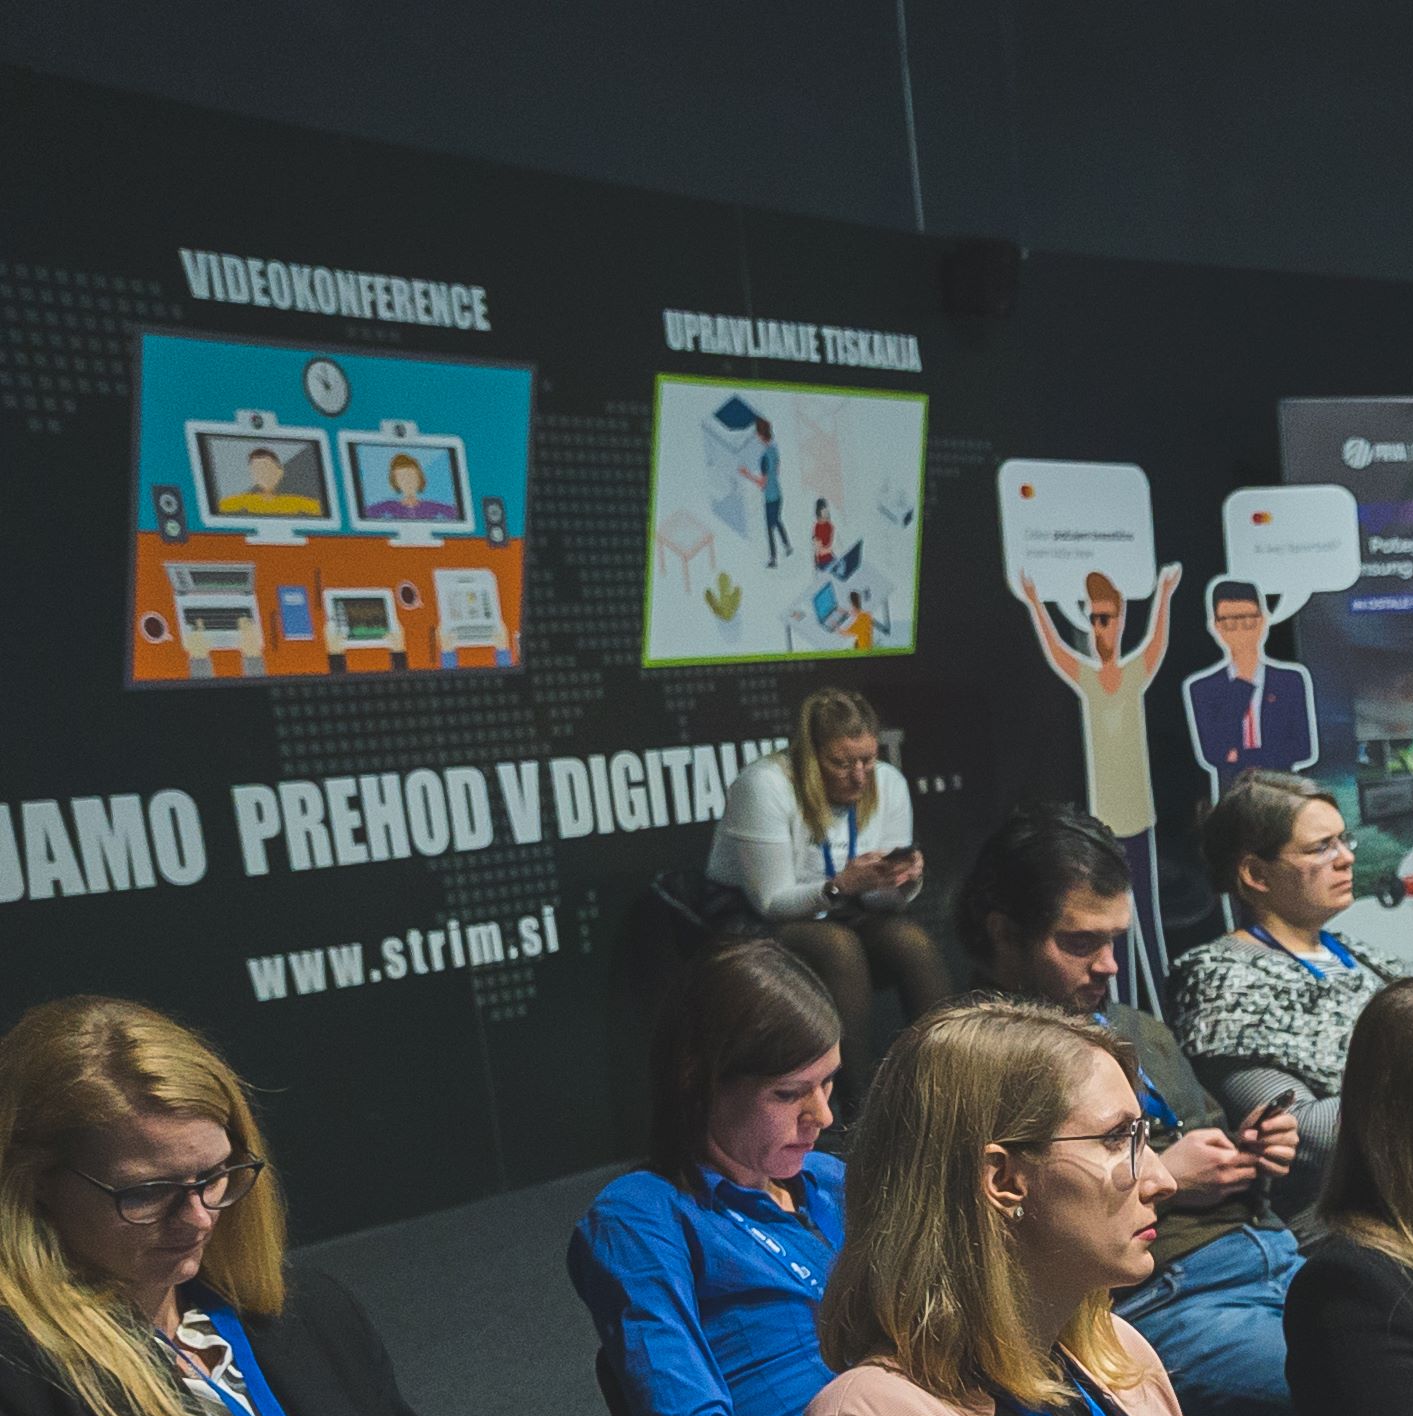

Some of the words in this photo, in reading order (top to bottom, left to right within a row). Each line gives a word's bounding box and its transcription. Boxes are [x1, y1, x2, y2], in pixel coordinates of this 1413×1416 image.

[179, 248, 492, 332] VIDEOKONFERENCE
[663, 308, 821, 363] UPRAVLJANJE
[821, 325, 923, 373] TISKANJA
[231, 768, 494, 877] PREHOD
[496, 760, 543, 845] V
[549, 737, 789, 839] DIGITAL
[247, 905, 560, 1002] www.strim.si
